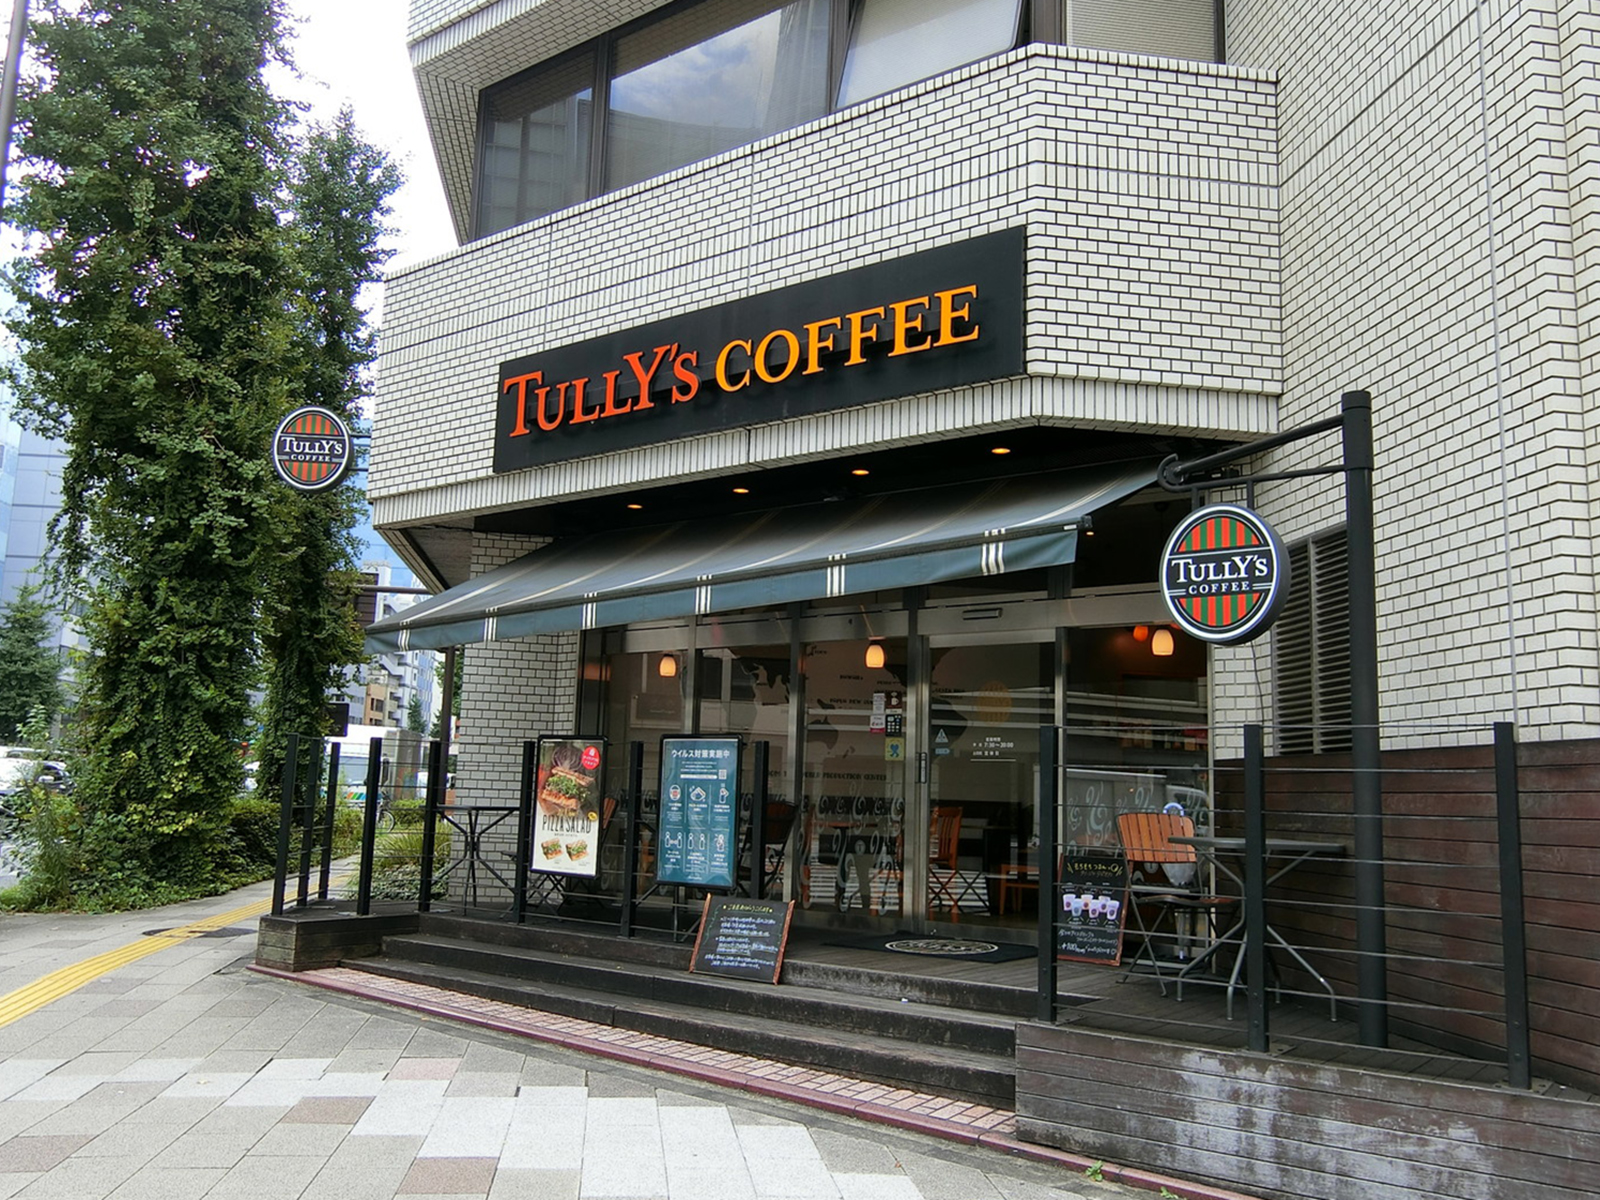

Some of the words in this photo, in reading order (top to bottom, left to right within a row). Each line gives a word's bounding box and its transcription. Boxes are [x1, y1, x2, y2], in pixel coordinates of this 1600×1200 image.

[503, 342, 700, 437] TULLY'S
[716, 284, 979, 392] COFFEE
[281, 437, 343, 454] TULLY'S
[291, 454, 331, 462] COFFEE
[1171, 554, 1268, 583] TULLY'S
[1189, 581, 1250, 594] COFFEE
